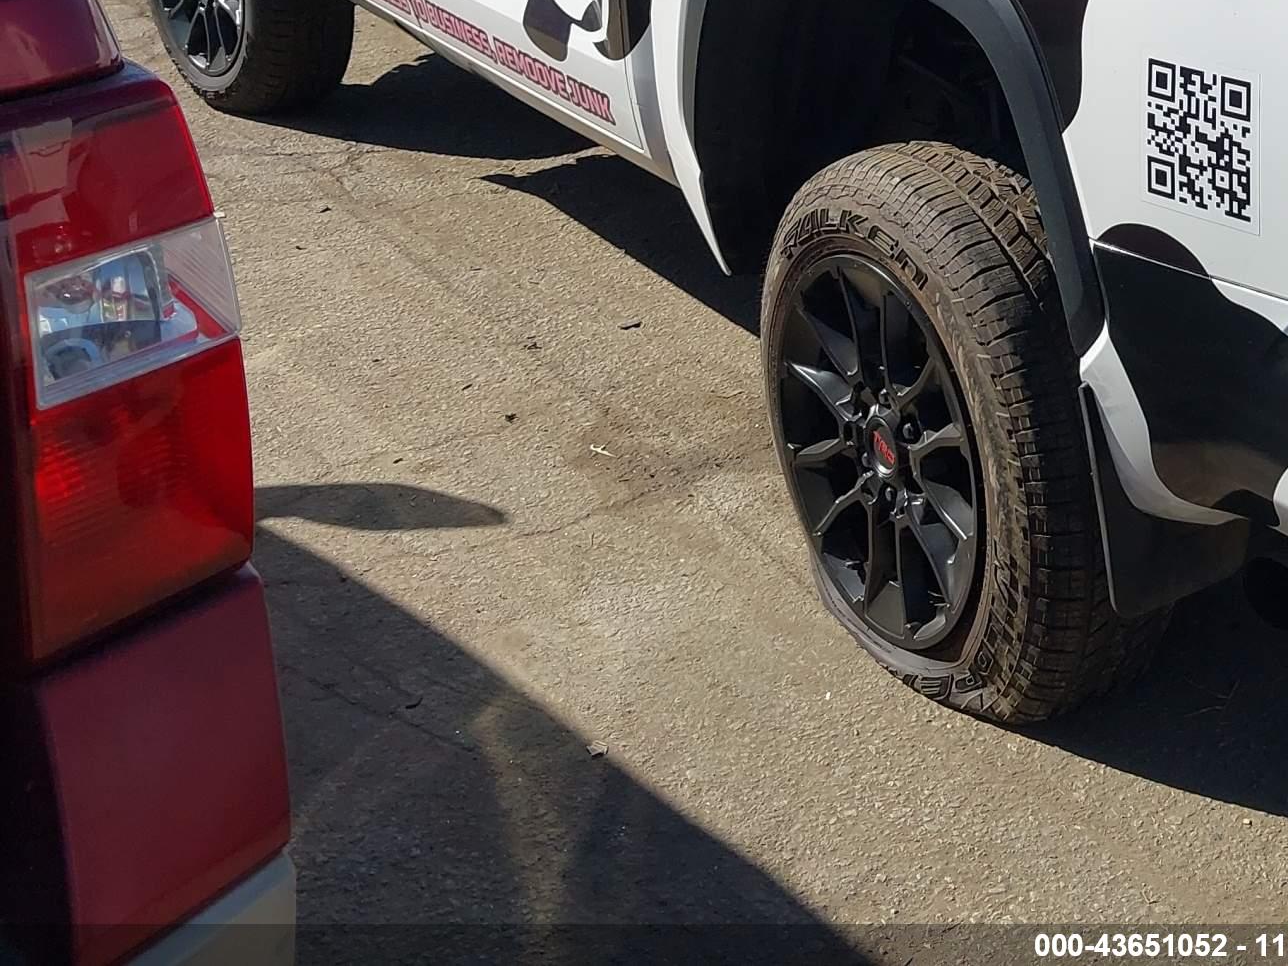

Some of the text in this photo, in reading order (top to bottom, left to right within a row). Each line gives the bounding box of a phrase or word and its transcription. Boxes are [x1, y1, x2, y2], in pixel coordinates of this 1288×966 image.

[422, 0, 498, 64] BUSINESS,
[493, 35, 571, 101] REMOOVE
[565, 74, 616, 126] JUNK
